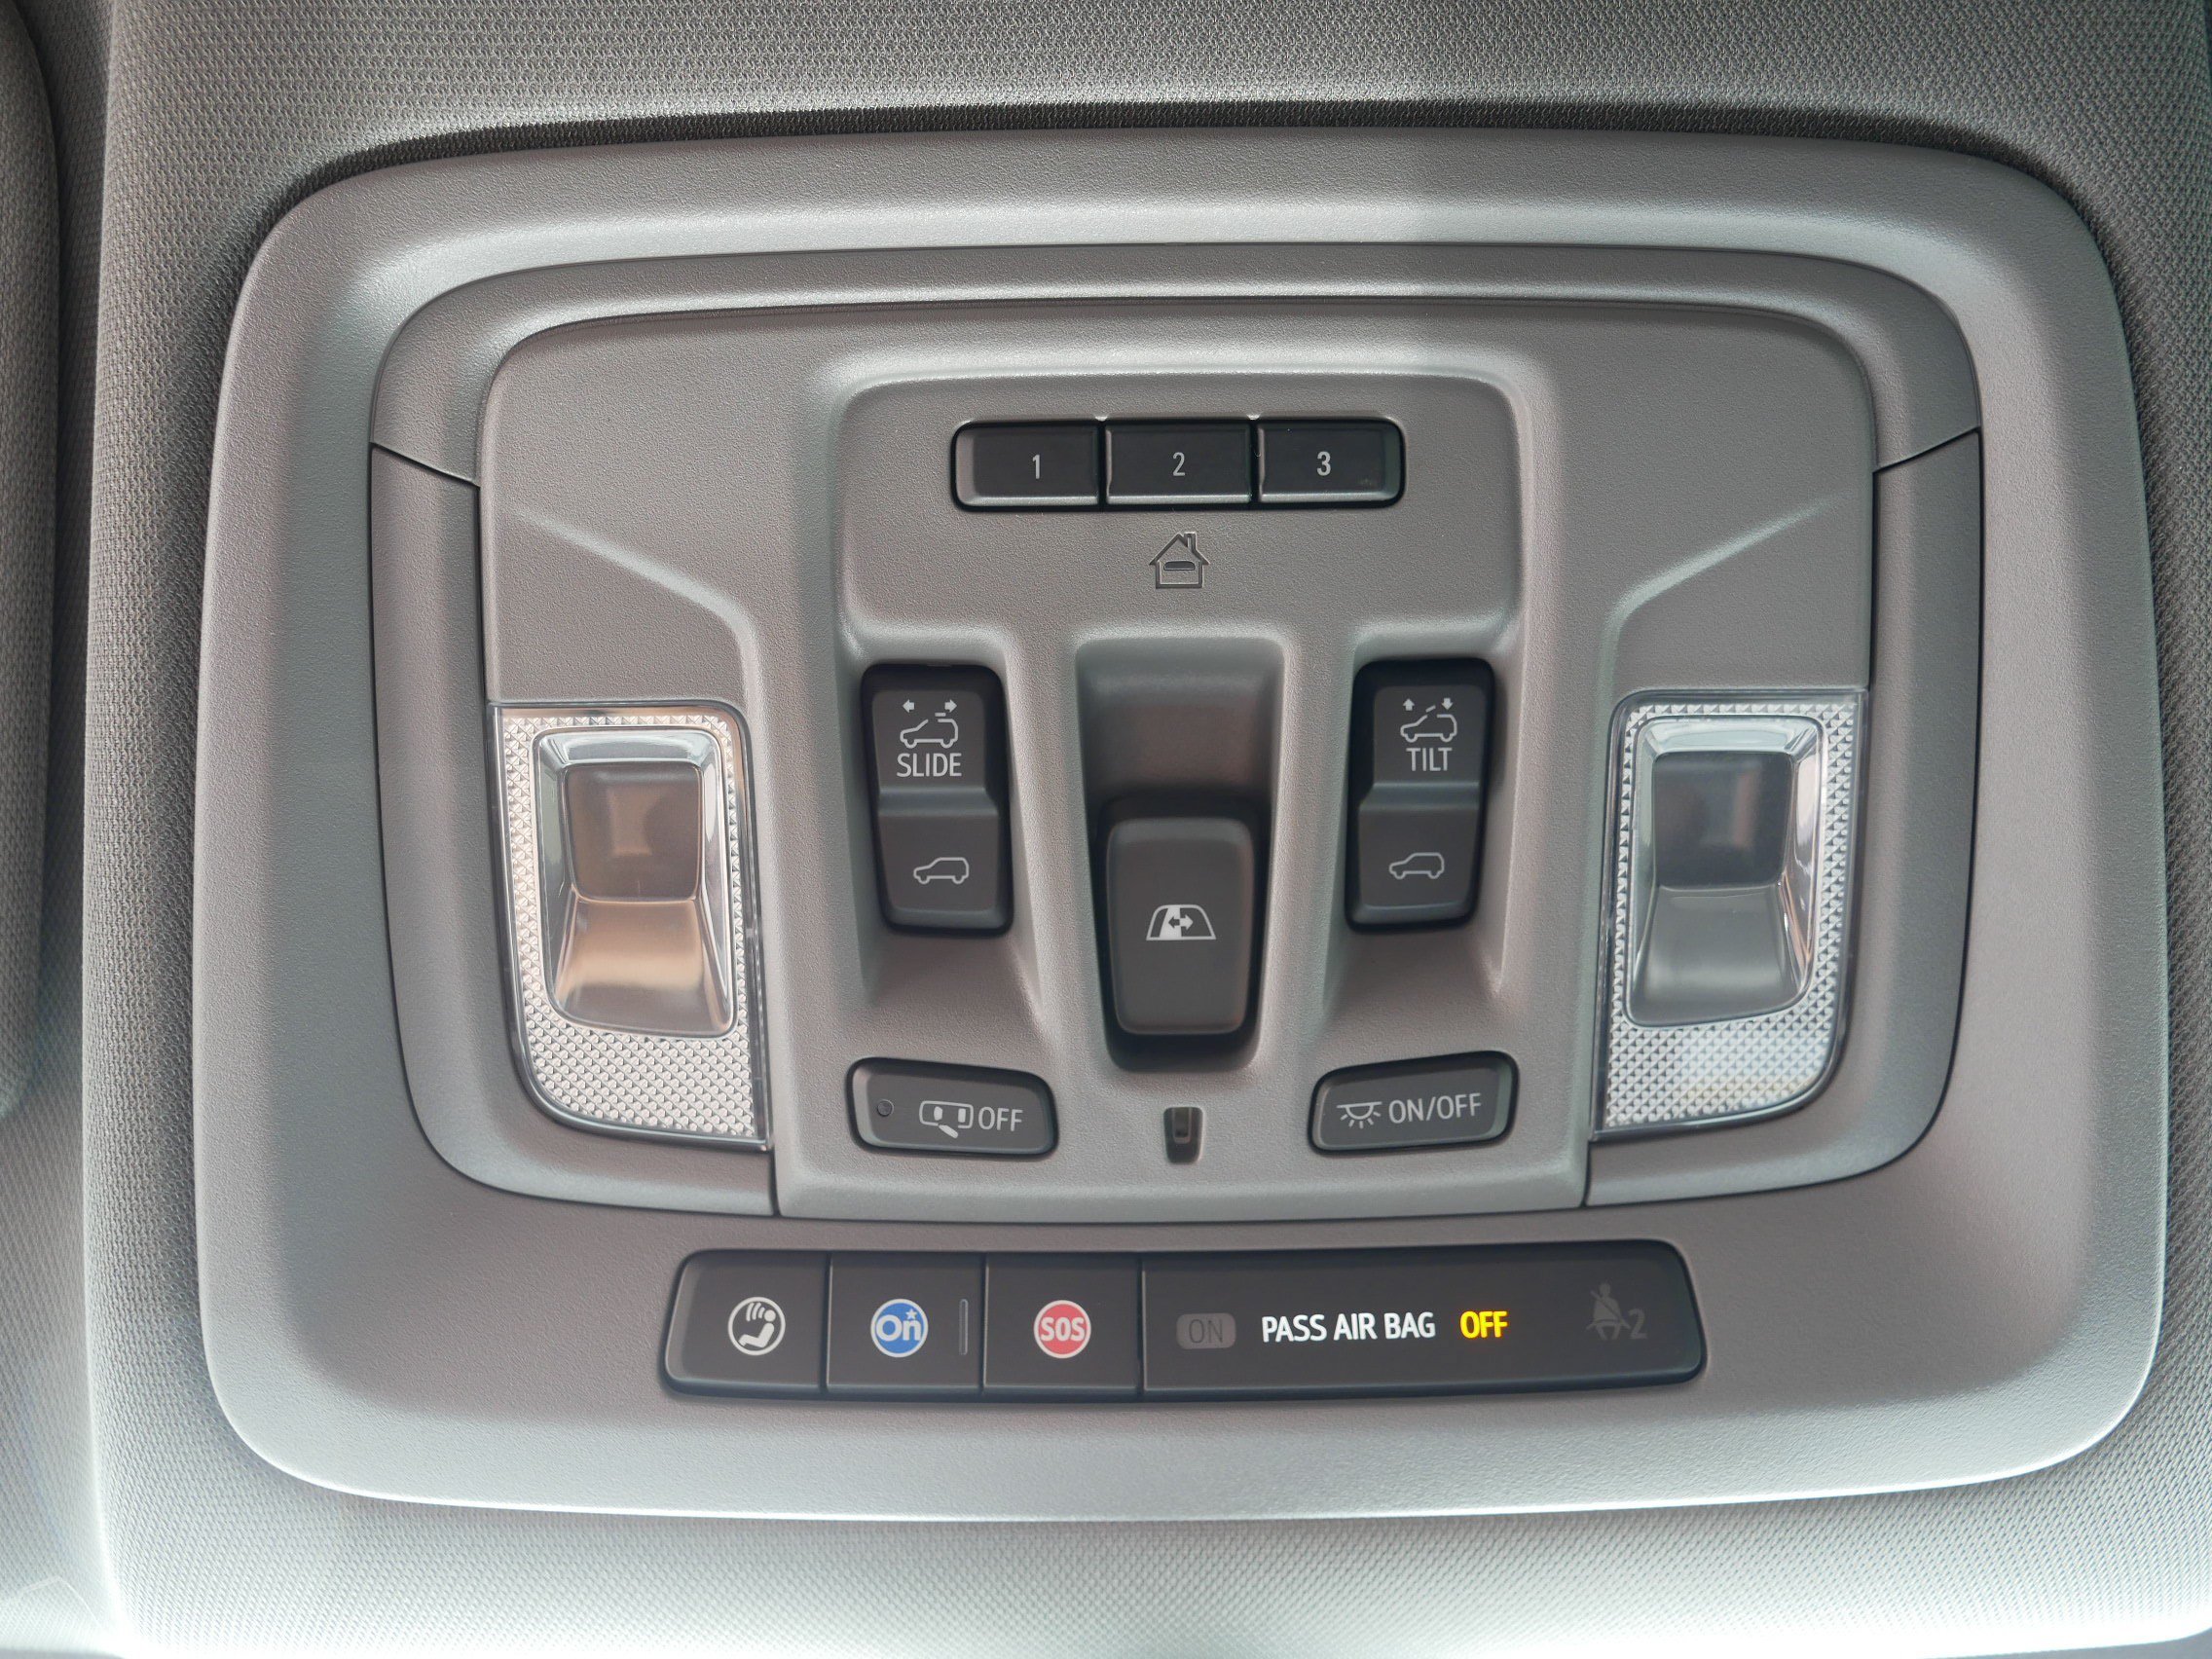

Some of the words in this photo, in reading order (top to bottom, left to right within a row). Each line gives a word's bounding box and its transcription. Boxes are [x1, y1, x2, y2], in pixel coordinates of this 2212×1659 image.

[1031, 454, 1042, 480] 1
[1172, 452, 1186, 477] 2
[1316, 451, 1332, 477] 3
[896, 753, 963, 778] SLIDE
[1405, 747, 1454, 772] TILT
[977, 1106, 1023, 1132] OFF
[1388, 1092, 1482, 1124] ON/OFF
[875, 1312, 922, 1343] On
[1039, 1316, 1086, 1343] SOS
[1188, 1317, 1224, 1346] ON
[1262, 1313, 1328, 1344] PASS
[1333, 1312, 1378, 1342] AIR
[1383, 1311, 1436, 1341] BAG
[1459, 1310, 1509, 1340] OFF
[1629, 1309, 1648, 1340] 2
